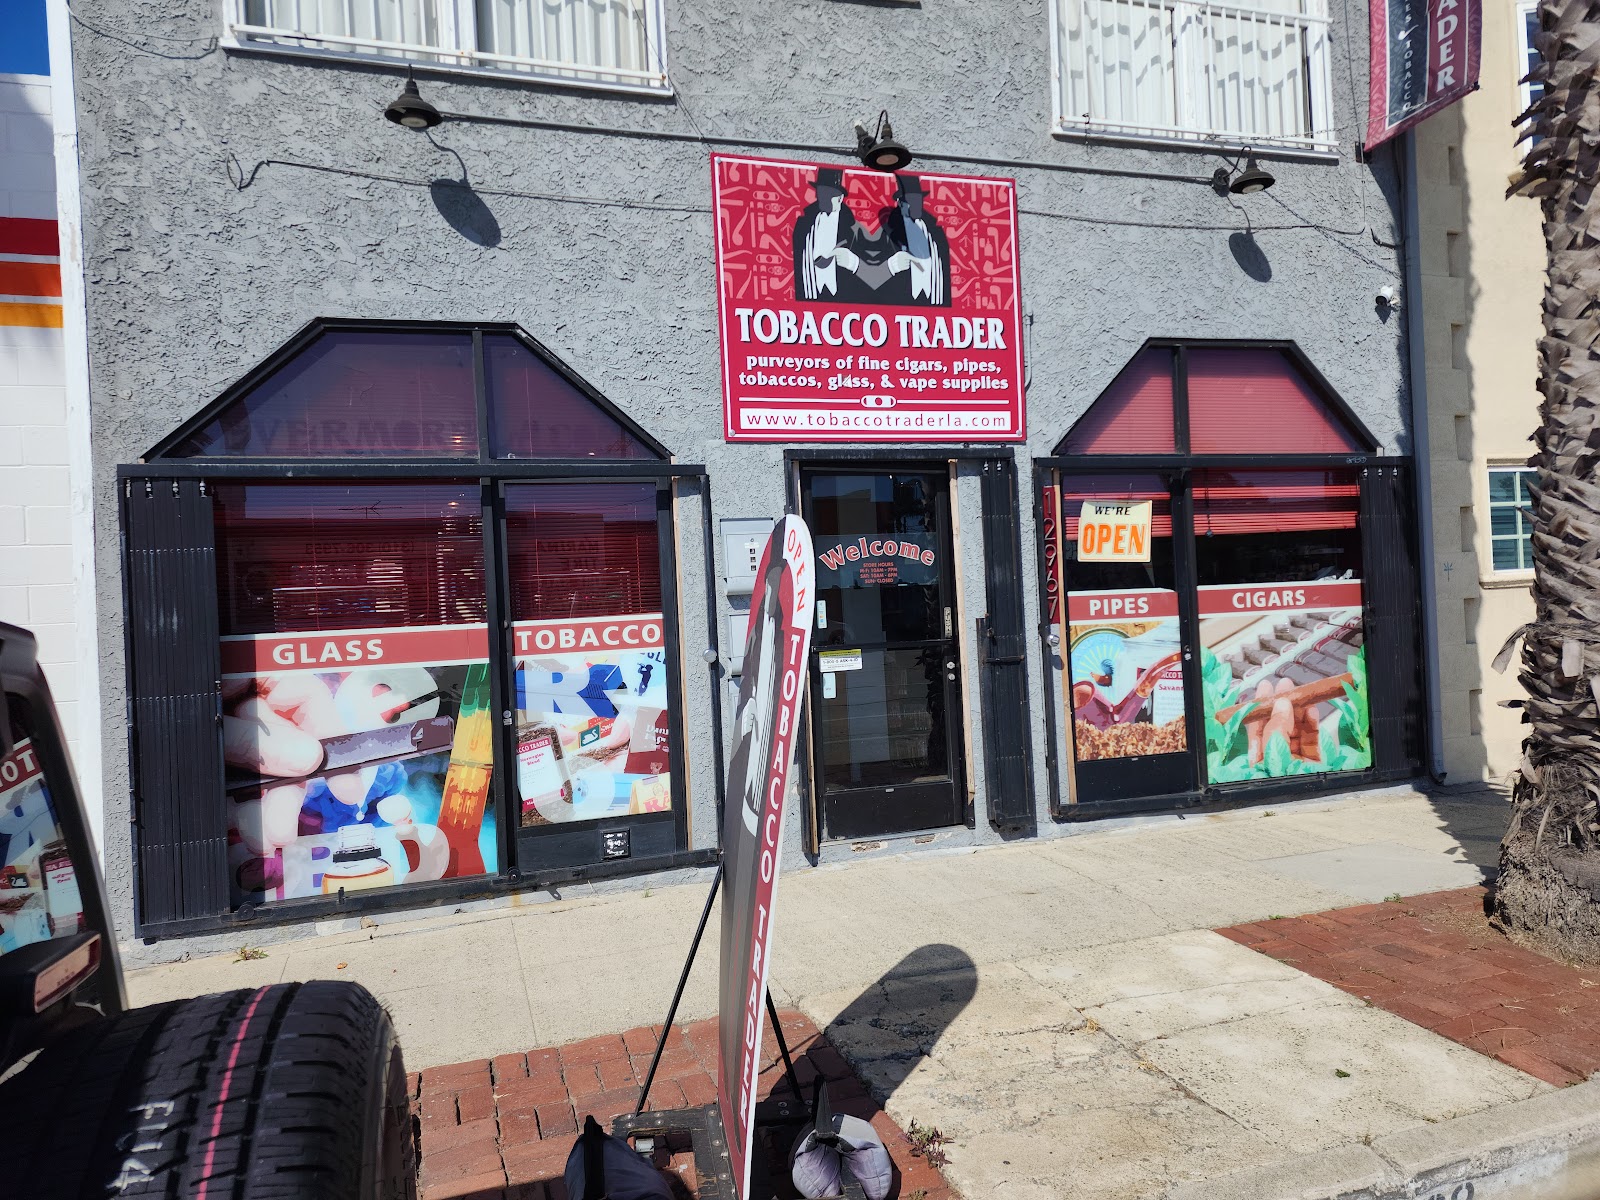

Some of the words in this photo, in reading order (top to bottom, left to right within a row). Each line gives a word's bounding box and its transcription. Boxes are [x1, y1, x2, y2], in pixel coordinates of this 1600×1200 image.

[1404, 0, 1413, 23] ES
[1402, 40, 1414, 112] TOBACCO
[735, 308, 888, 347] TOBACCO
[895, 314, 1008, 350] TRADER
[746, 354, 830, 371] purveyors
[836, 356, 854, 369] of
[858, 356, 891, 371] fine
[895, 357, 948, 375] cigars,
[953, 357, 1002, 377] pipes,
[739, 372, 823, 389] tobaccos,
[828, 373, 876, 391] glass,
[880, 375, 895, 389] &
[899, 377, 937, 393] vape
[942, 373, 1009, 391] supplies
[747, 413, 1006, 427] www.tobaccotraderla.com
[1095, 506, 1132, 516] WE'RE
[1081, 522, 1147, 555] OPEN
[819, 537, 935, 571] Welcome
[1043, 491, 1059, 620] 12967
[787, 529, 807, 613] OPEN
[1089, 597, 1150, 616] PIPES
[1232, 590, 1306, 609] CIGARS
[517, 623, 661, 651] TOBACCO
[272, 639, 384, 665] GLASS
[530, 739, 549, 751] TRADER
[760, 634, 802, 884] TOBACCO
[740, 904, 768, 1129] TRADER
